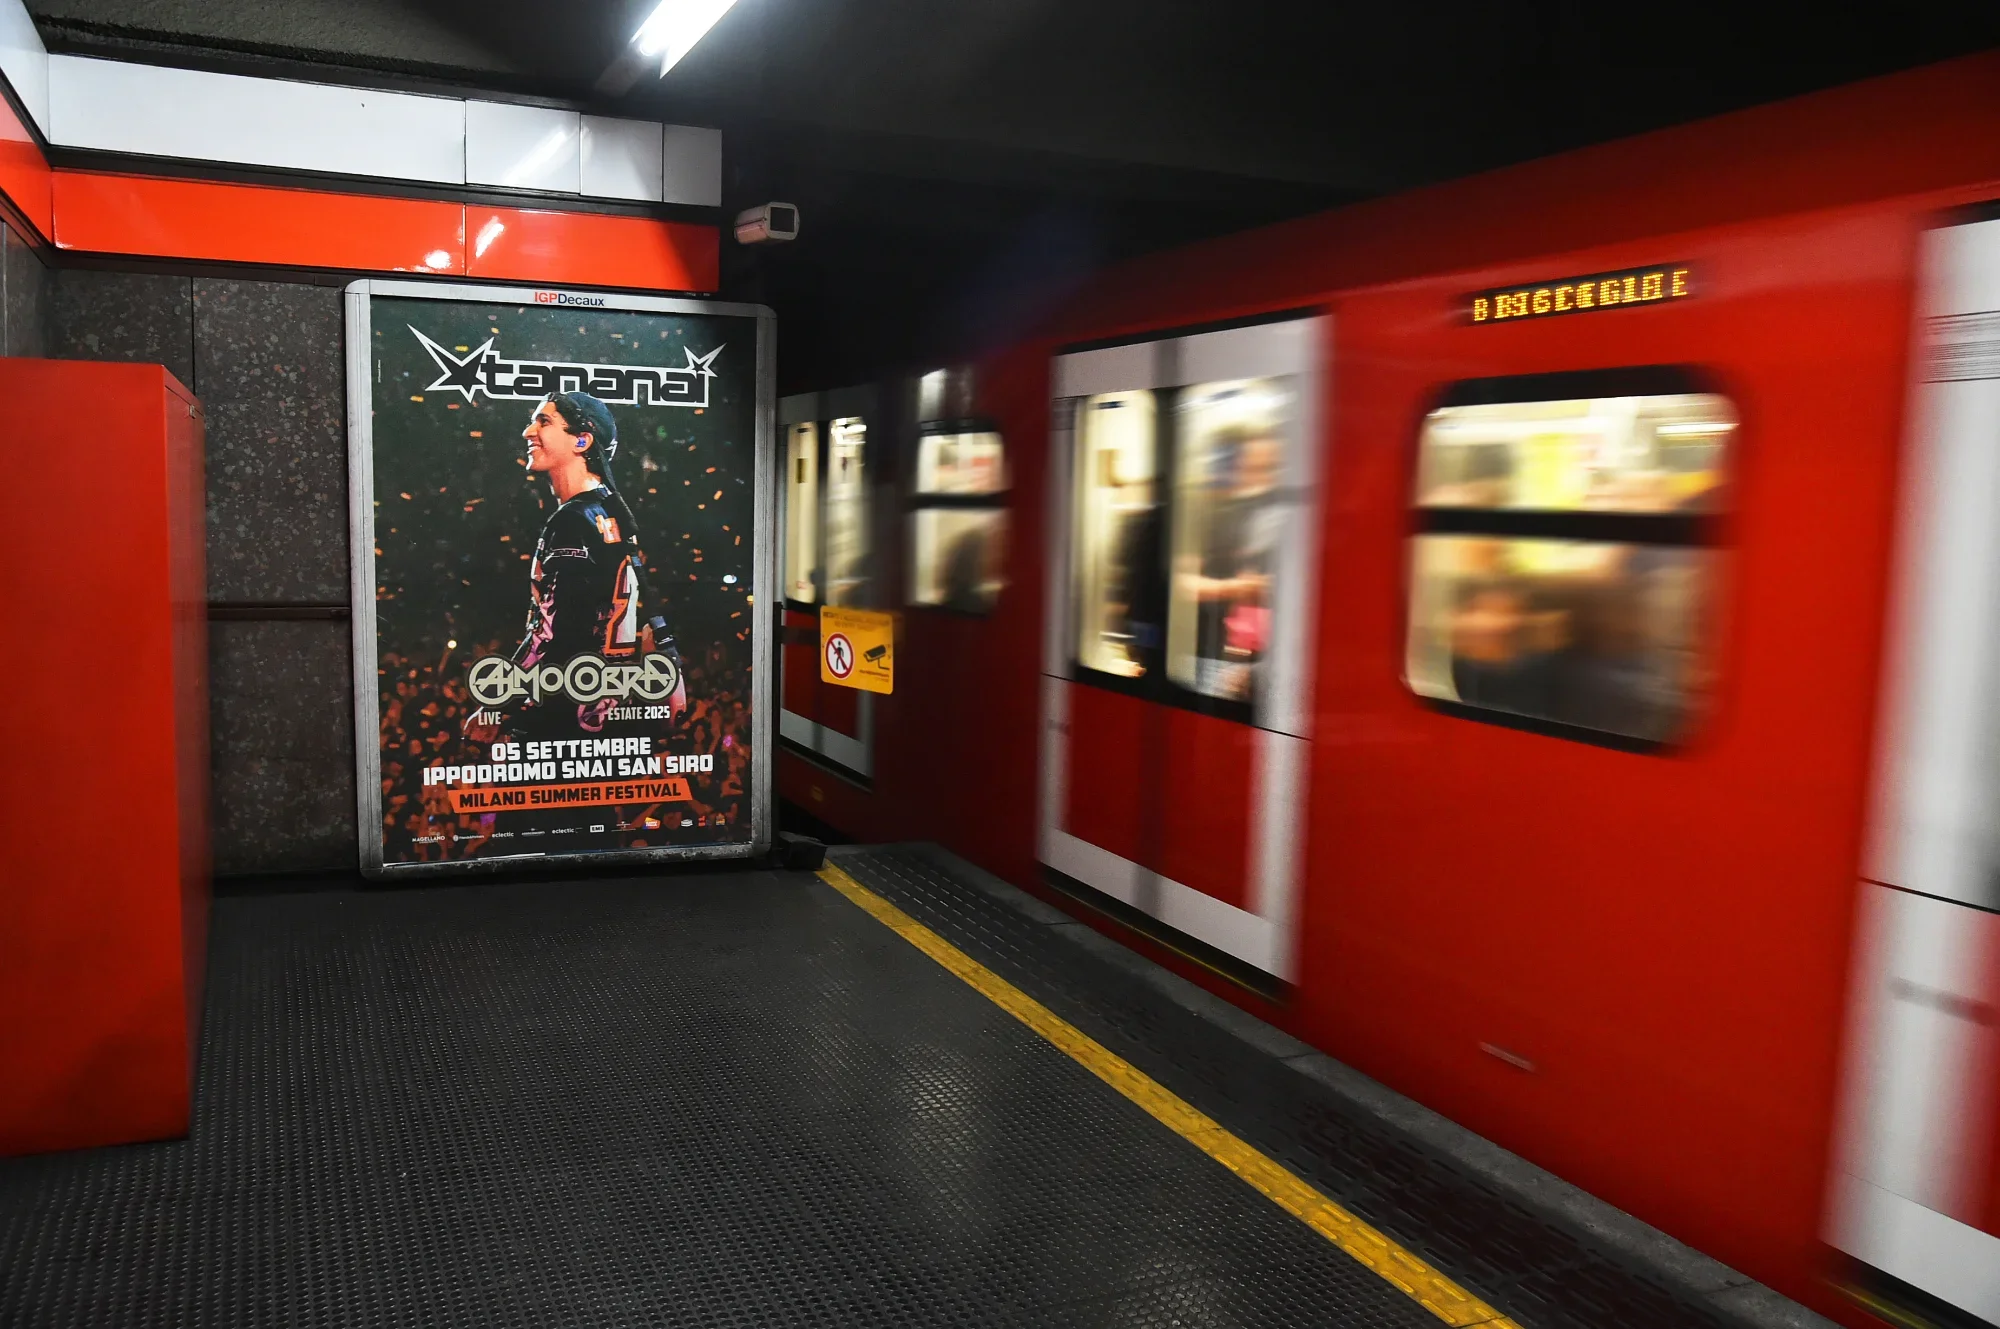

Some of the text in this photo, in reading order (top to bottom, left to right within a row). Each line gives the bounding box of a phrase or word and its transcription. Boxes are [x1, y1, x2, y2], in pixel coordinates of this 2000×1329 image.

[534, 292, 605, 307] IGPDecaux
[478, 711, 502, 726] LIVE
[608, 705, 671, 721] ESTATE 2025
[491, 737, 652, 762] 05 SETTEMBRE
[423, 754, 714, 786] IPPODROMO SNAI SAN SIRO
[459, 782, 682, 808] MILANO SUMMER FESTIVAL
